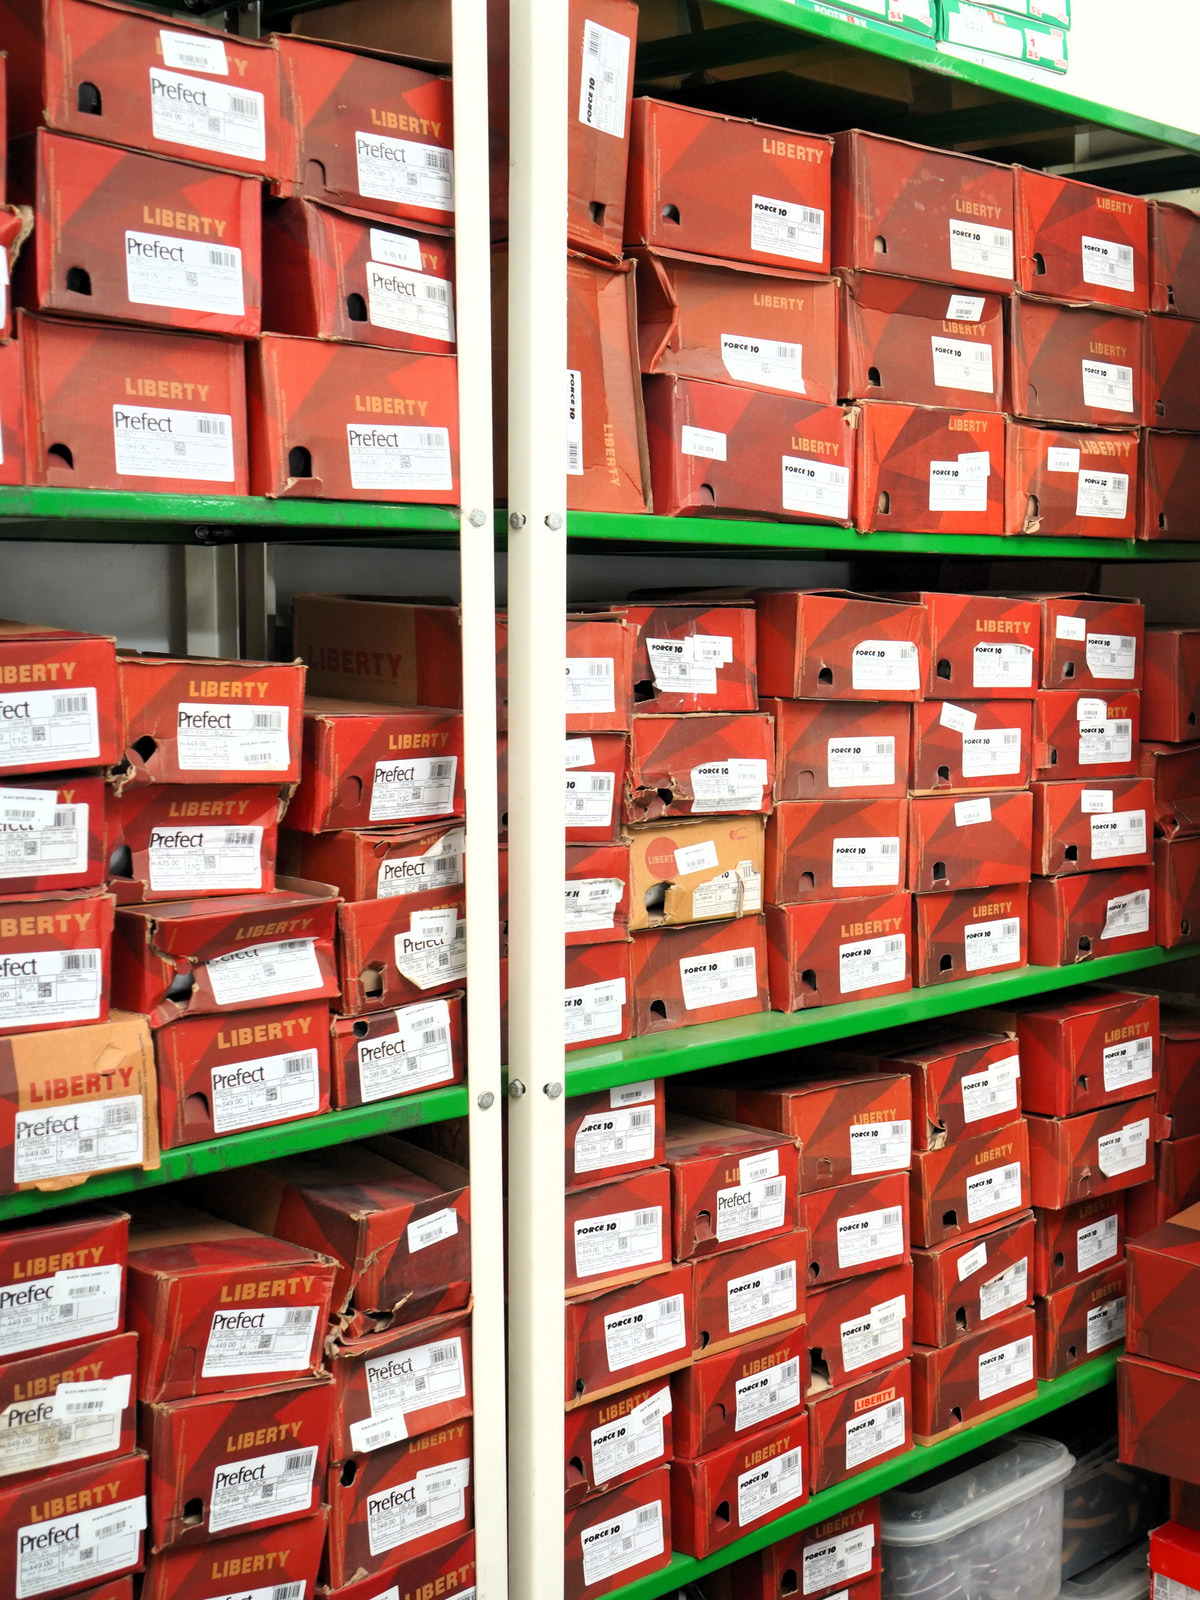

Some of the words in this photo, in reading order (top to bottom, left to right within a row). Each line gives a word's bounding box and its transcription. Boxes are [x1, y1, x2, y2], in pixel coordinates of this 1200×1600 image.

[151, 77, 208, 108] Prefect
[586, 89, 595, 123] FORCE
[371, 109, 441, 138] LIBERTY
[357, 140, 406, 164] Prefect
[762, 138, 824, 164] LIBERTY
[754, 202, 777, 214] FORCE
[778, 209, 787, 217] 10
[956, 200, 1001, 220] LIBERTY
[1097, 197, 1133, 215] LIBERTY
[143, 205, 227, 238] LIBERTY
[953, 229, 971, 238] FORCE
[973, 233, 980, 241] 10
[127, 238, 184, 263] Prefect
[373, 273, 416, 297] Prefect
[753, 293, 804, 311] LIBERTY
[724, 341, 748, 351] FORCE
[750, 345, 759, 353] 10
[1090, 342, 1127, 358] LIBERTY
[126, 377, 209, 401] LIBERTY
[356, 395, 428, 417] LIBERTY
[115, 412, 173, 433] Prefect
[948, 418, 988, 432] LIBERTY
[349, 429, 399, 448] Prefect
[791, 436, 839, 456] LIBERTY
[1080, 439, 1131, 457] LIBERTY
[603, 423, 621, 488] LIBERTY
[785, 465, 805, 475] FORCE
[975, 619, 1031, 634] LIBERTY
[651, 644, 673, 653] FORCE
[307, 645, 403, 678] LIBERTY
[189, 681, 269, 698] LIBERTY
[178, 711, 231, 729] Prefect
[389, 733, 449, 750] LIBERTY
[375, 766, 415, 783] Prefect
[169, 800, 250, 817] LIBERTY
[150, 831, 203, 849] Prefect
[857, 847, 866, 855] 10
[384, 861, 425, 879] Prefect
[972, 902, 1012, 918] LIBERTY
[1, 912, 92, 937] BERTY
[235, 918, 314, 940] LIBERTY
[841, 918, 902, 938] LIBERTY
[684, 966, 707, 974] FORCE
[708, 963, 717, 971] 10
[217, 1016, 312, 1049] LIBERTY
[1104, 1021, 1150, 1044] LIBERTY
[361, 1038, 406, 1063] Prefect
[30, 1068, 133, 1104] LIBERTY
[213, 1066, 265, 1090] Prefect
[16, 1114, 79, 1139] Prefect
[975, 1143, 1014, 1166] LIBERTY
[718, 1191, 751, 1211] Prefect
[576, 1224, 605, 1235] FORCE
[606, 1222, 616, 1231] 10
[13, 1246, 105, 1279] LIBERTY
[0, 1285, 54, 1309] Prefec
[220, 1277, 315, 1303] LIBERTY
[213, 1311, 265, 1331] Prefect
[367, 1357, 413, 1383] Prefect
[742, 1349, 790, 1377] LIBERTY
[856, 1391, 893, 1410] LIBERTY
[8, 1403, 53, 1427] Prefe
[227, 1421, 303, 1453] LIBERTY
[409, 1425, 464, 1454] LIBERTY
[745, 1436, 790, 1468] LIBERTY
[216, 1464, 266, 1489] Prefect
[31, 1481, 121, 1522] LIBERTY
[369, 1487, 416, 1516] Prefect
[21, 1523, 80, 1553] Prefect
[584, 1530, 610, 1545] FORCE
[610, 1524, 620, 1535] 10
[212, 1550, 290, 1579] LIBERTY
